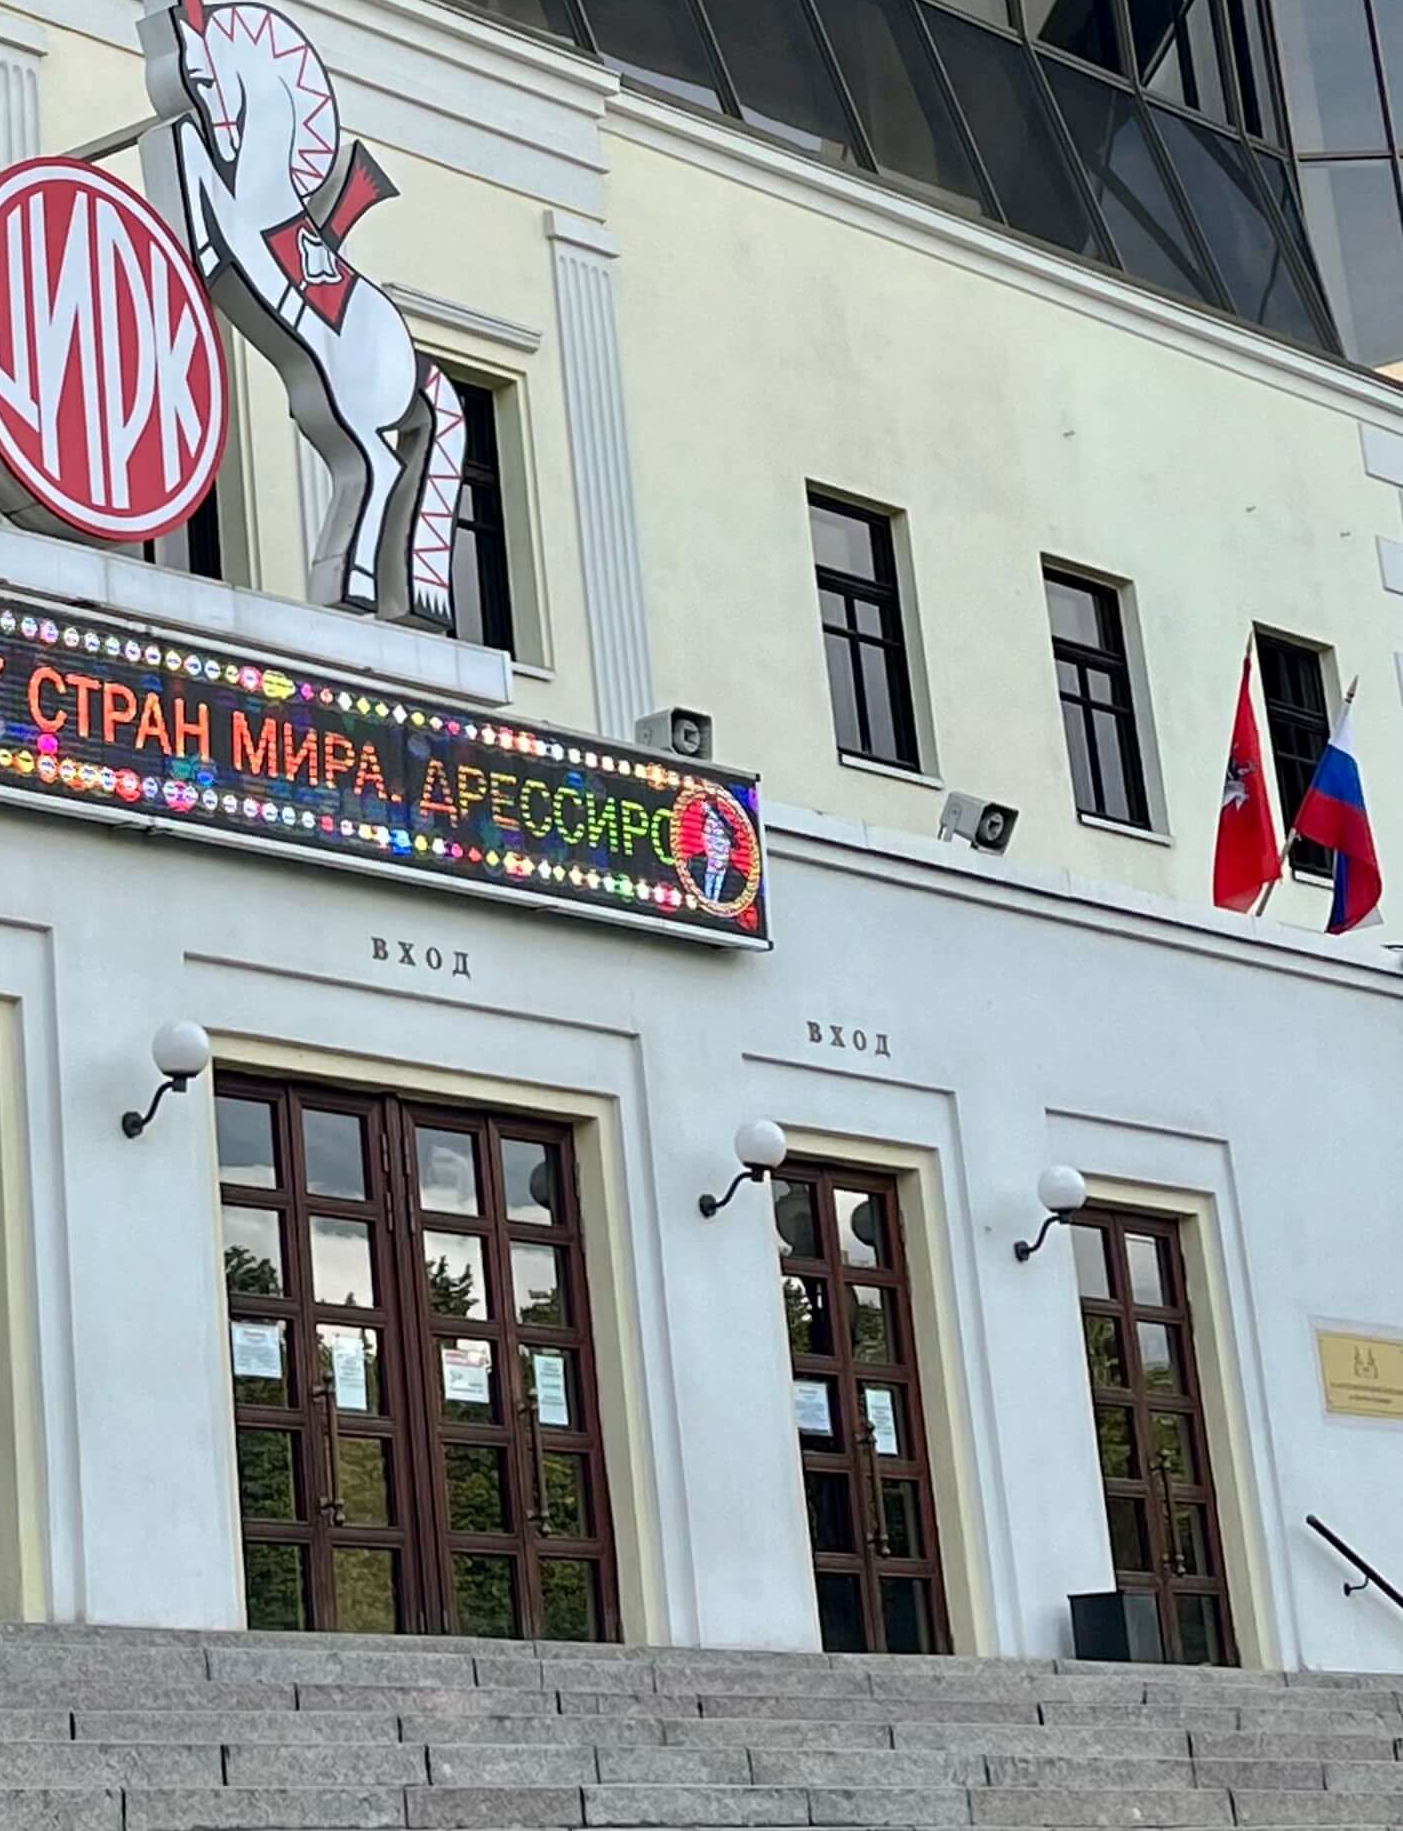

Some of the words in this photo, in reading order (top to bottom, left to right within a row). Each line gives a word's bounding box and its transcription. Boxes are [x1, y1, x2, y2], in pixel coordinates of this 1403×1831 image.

[27, 665, 210, 763] СТРАН
[232, 710, 403, 802] МИРА.
[371, 936, 471, 980] ВХОД
[806, 1020, 891, 1058] ВХОД
